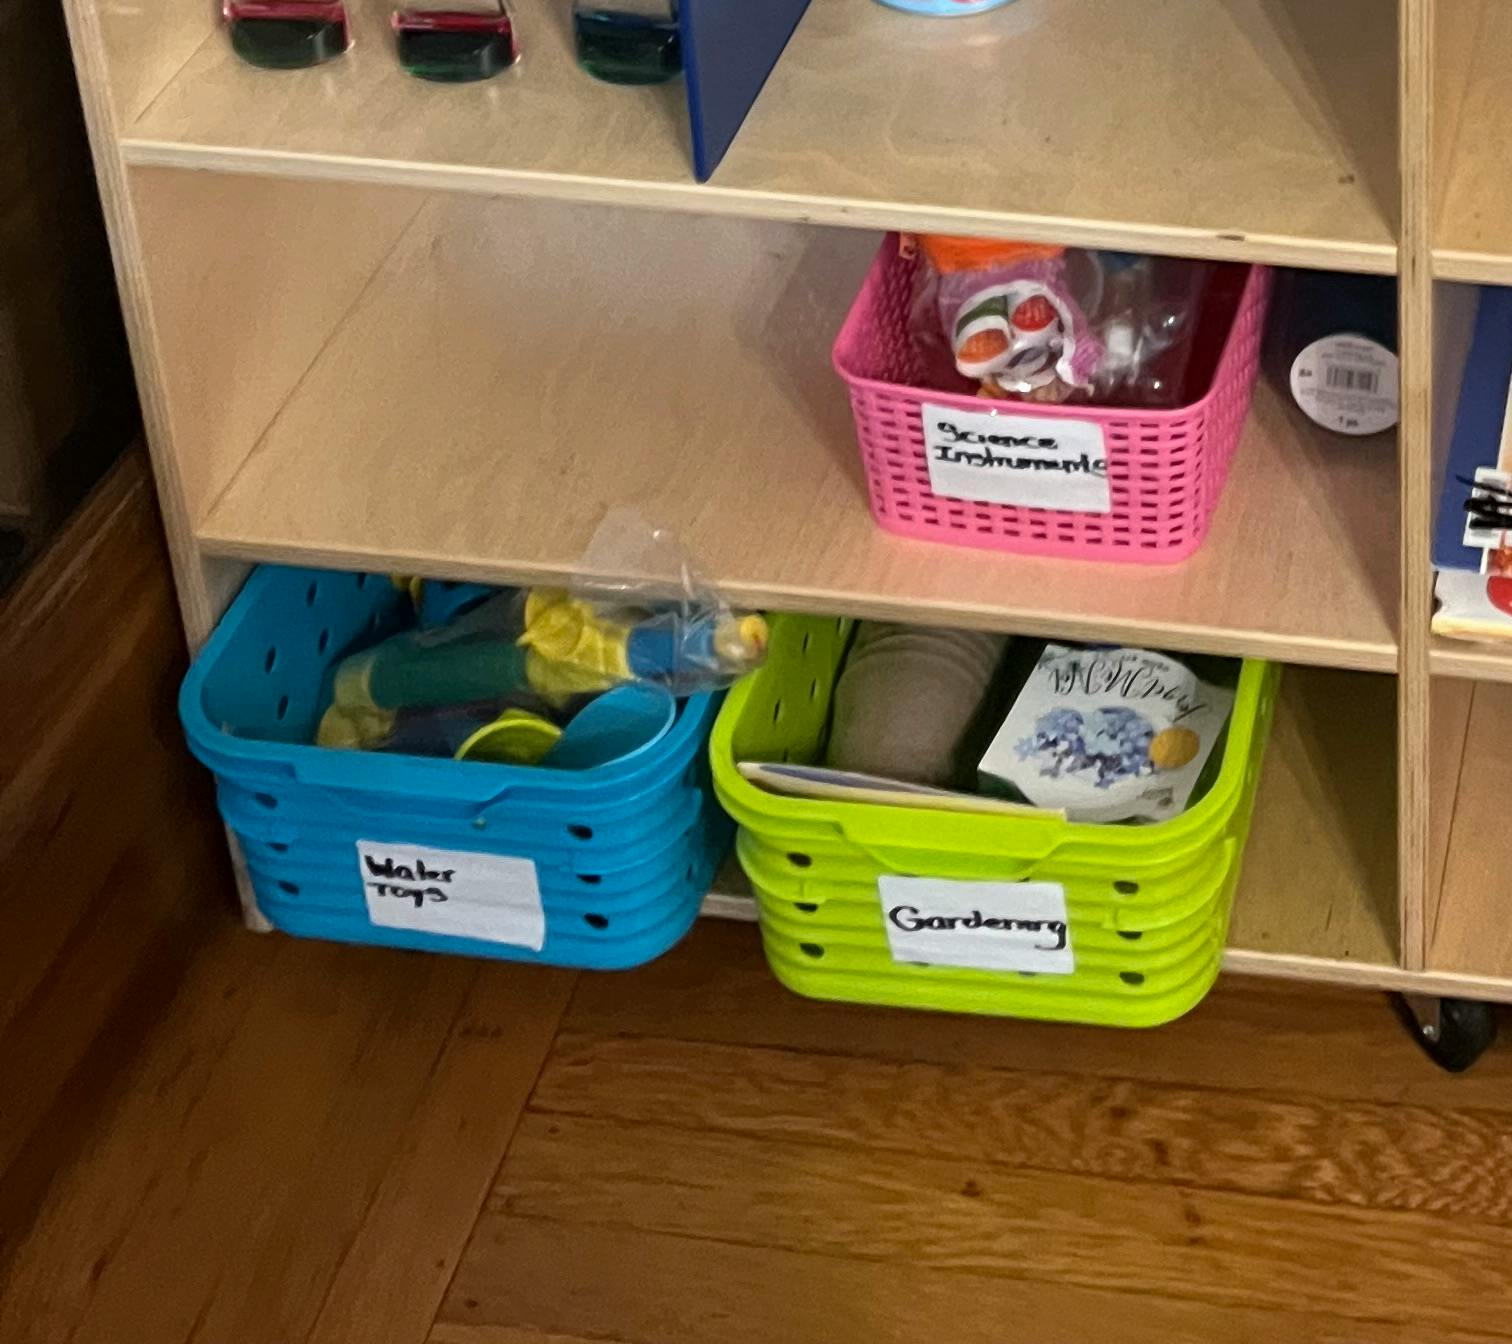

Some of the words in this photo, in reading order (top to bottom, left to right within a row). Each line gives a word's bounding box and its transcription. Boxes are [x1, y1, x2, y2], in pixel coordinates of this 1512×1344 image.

[938, 420, 1058, 450] Science
[365, 853, 456, 884] Water
[888, 904, 1068, 951] Gardening
